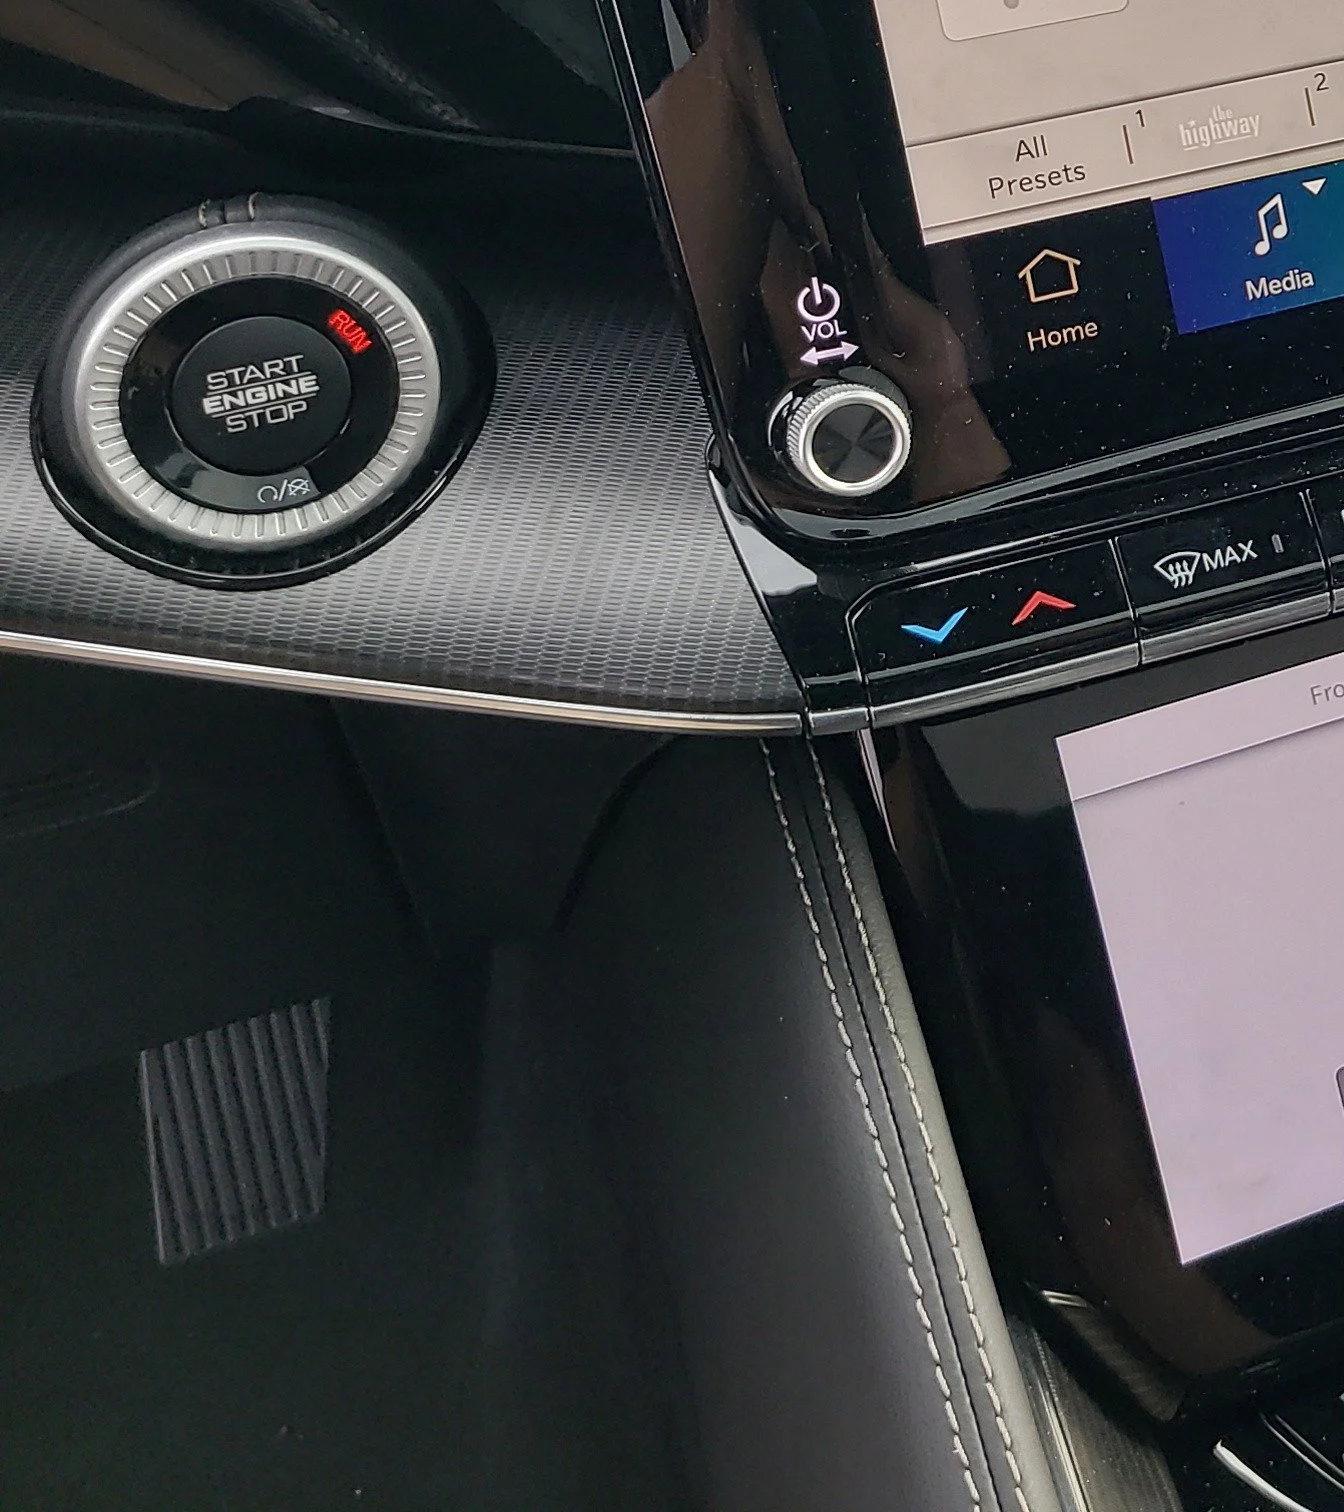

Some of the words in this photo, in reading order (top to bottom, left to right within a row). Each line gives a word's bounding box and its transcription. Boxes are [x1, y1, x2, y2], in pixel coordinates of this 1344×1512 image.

[1315, 73, 1328, 92] 2
[1135, 110, 1147, 128] 1
[1179, 114, 1260, 148] highway
[1015, 135, 1049, 163] All
[988, 161, 1086, 199] Presets
[1245, 267, 1314, 302] Media
[327, 308, 373, 355] RUN
[801, 319, 848, 343] VOL
[1027, 318, 1099, 353] Home
[206, 355, 305, 390] START
[202, 374, 320, 416] ENGINE
[226, 399, 308, 434] STOP
[1202, 540, 1258, 573] MAX
